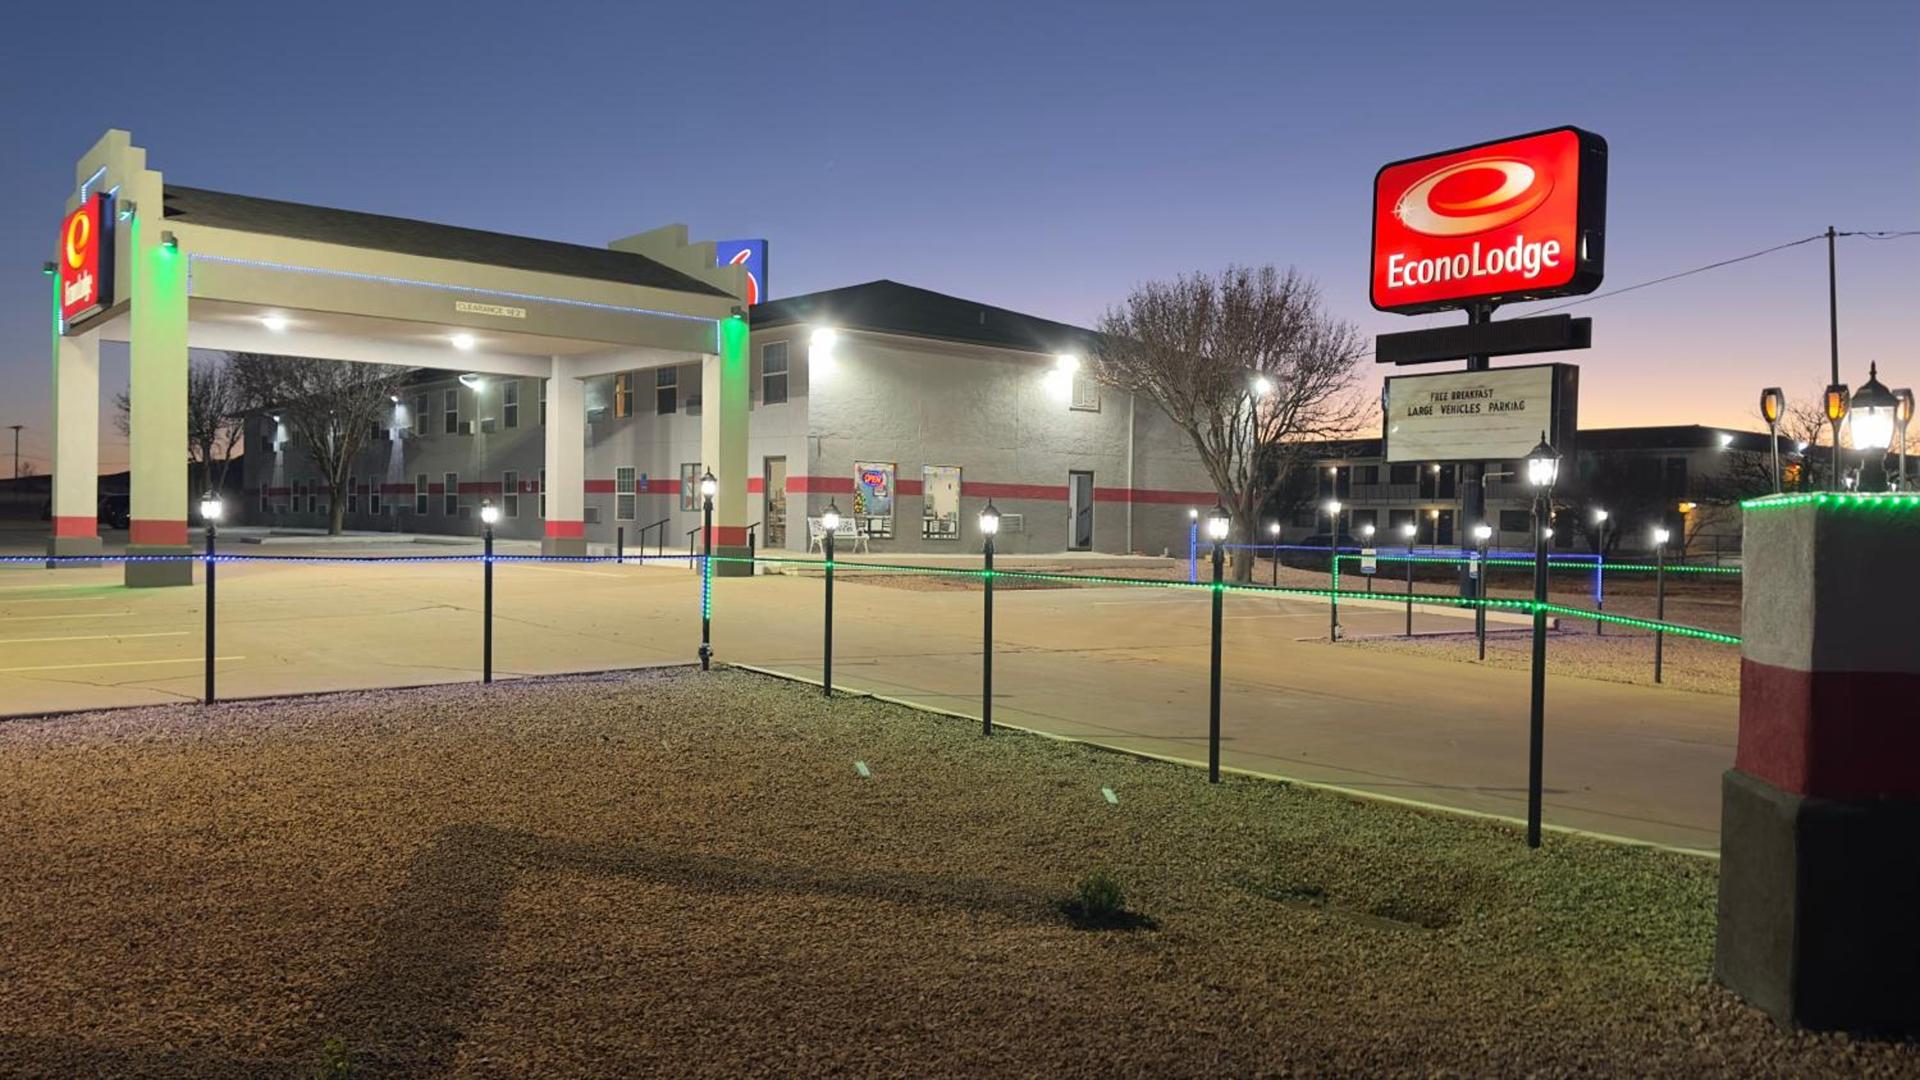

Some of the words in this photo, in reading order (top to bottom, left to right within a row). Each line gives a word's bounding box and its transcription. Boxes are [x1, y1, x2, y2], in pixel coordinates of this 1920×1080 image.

[1387, 235, 1560, 288] EconoLodge
[1451, 388, 1494, 400] BREAKFAST
[1408, 405, 1433, 416] LARGE
[1440, 403, 1481, 415] VEHICLES
